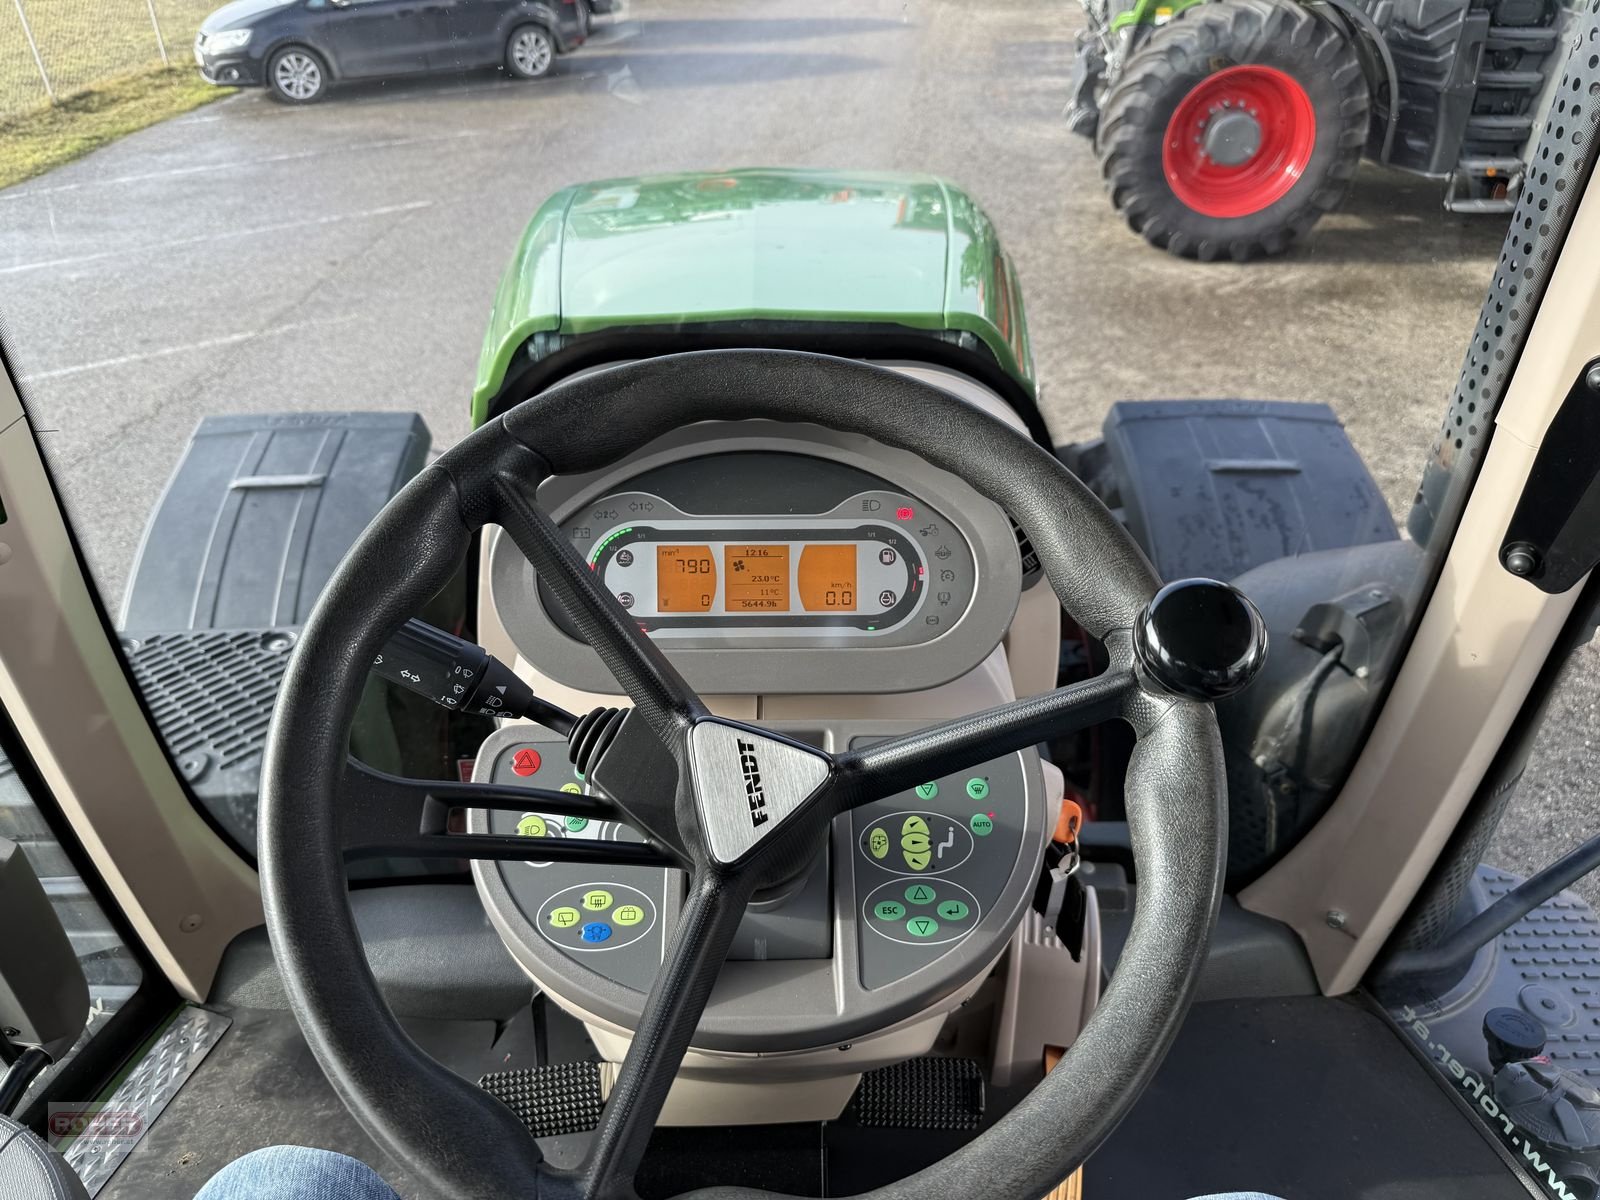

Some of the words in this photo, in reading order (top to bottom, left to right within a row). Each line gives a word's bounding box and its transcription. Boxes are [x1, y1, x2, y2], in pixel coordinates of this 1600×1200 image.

[675, 559, 710, 574] 790
[701, 594, 710, 607] 0
[825, 591, 852, 606] 0.0
[736, 738, 769, 828] FENDT
[882, 906, 898, 915] ESC
